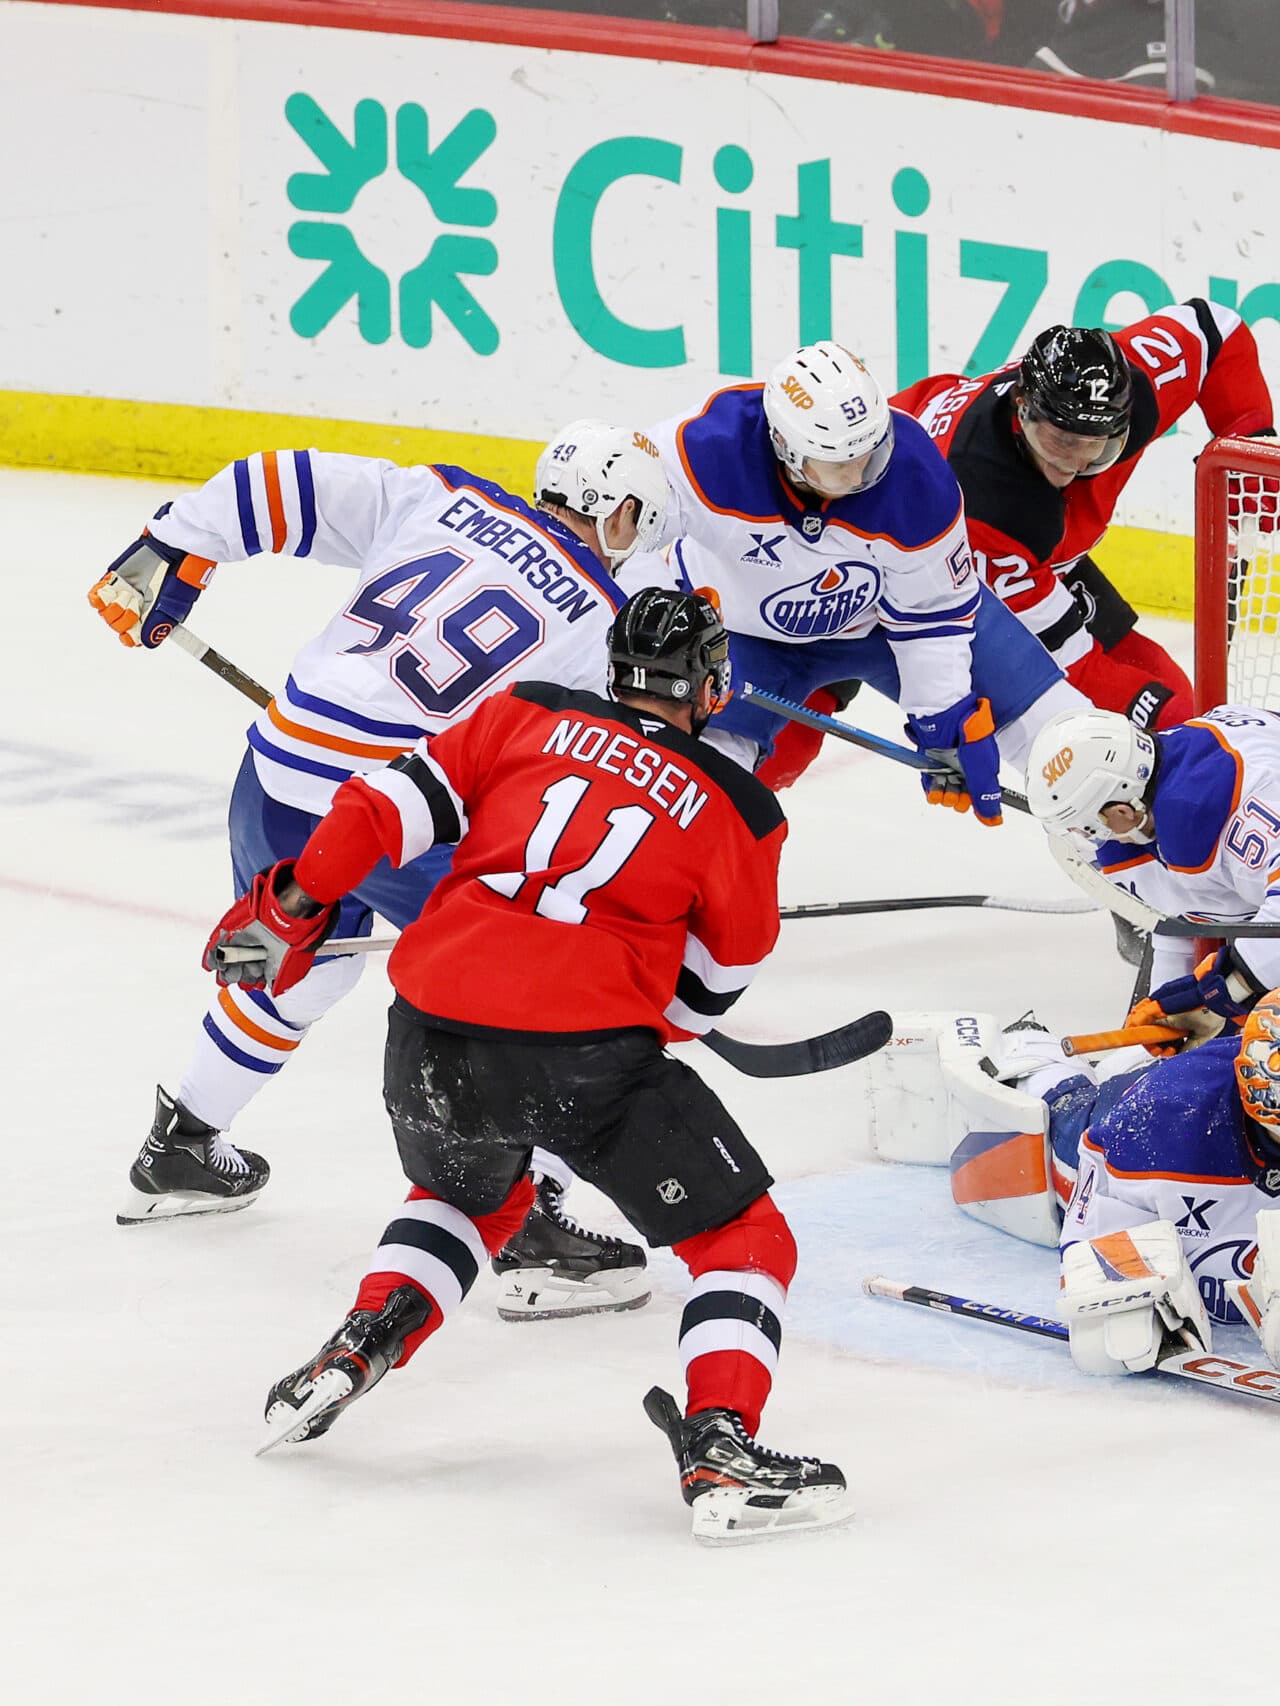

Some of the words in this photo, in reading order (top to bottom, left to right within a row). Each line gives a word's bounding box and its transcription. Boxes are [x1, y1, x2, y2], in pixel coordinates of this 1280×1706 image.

[1130, 326, 1188, 390] 12
[781, 375, 815, 411] SKIP
[1089, 378, 1110, 402] 12
[840, 395, 868, 421] 53
[1076, 411, 1114, 424] CCM
[552, 443, 578, 463] 49
[631, 431, 661, 459] SKIP
[848, 429, 878, 447] CCM
[437, 495, 599, 625] EMBERSON
[773, 581, 871, 635] OILERS
[336, 545, 545, 720] 49
[631, 666, 648, 690] 11
[540, 718, 710, 831] NOESEN
[1042, 746, 1074, 788] SKIP
[476, 774, 657, 926] 11
[955, 1016, 982, 1048] CCM
[712, 1136, 741, 1174] CCM
[1175, 1227, 1211, 1239] ARBON-X
[961, 1299, 1028, 1323] CCM
